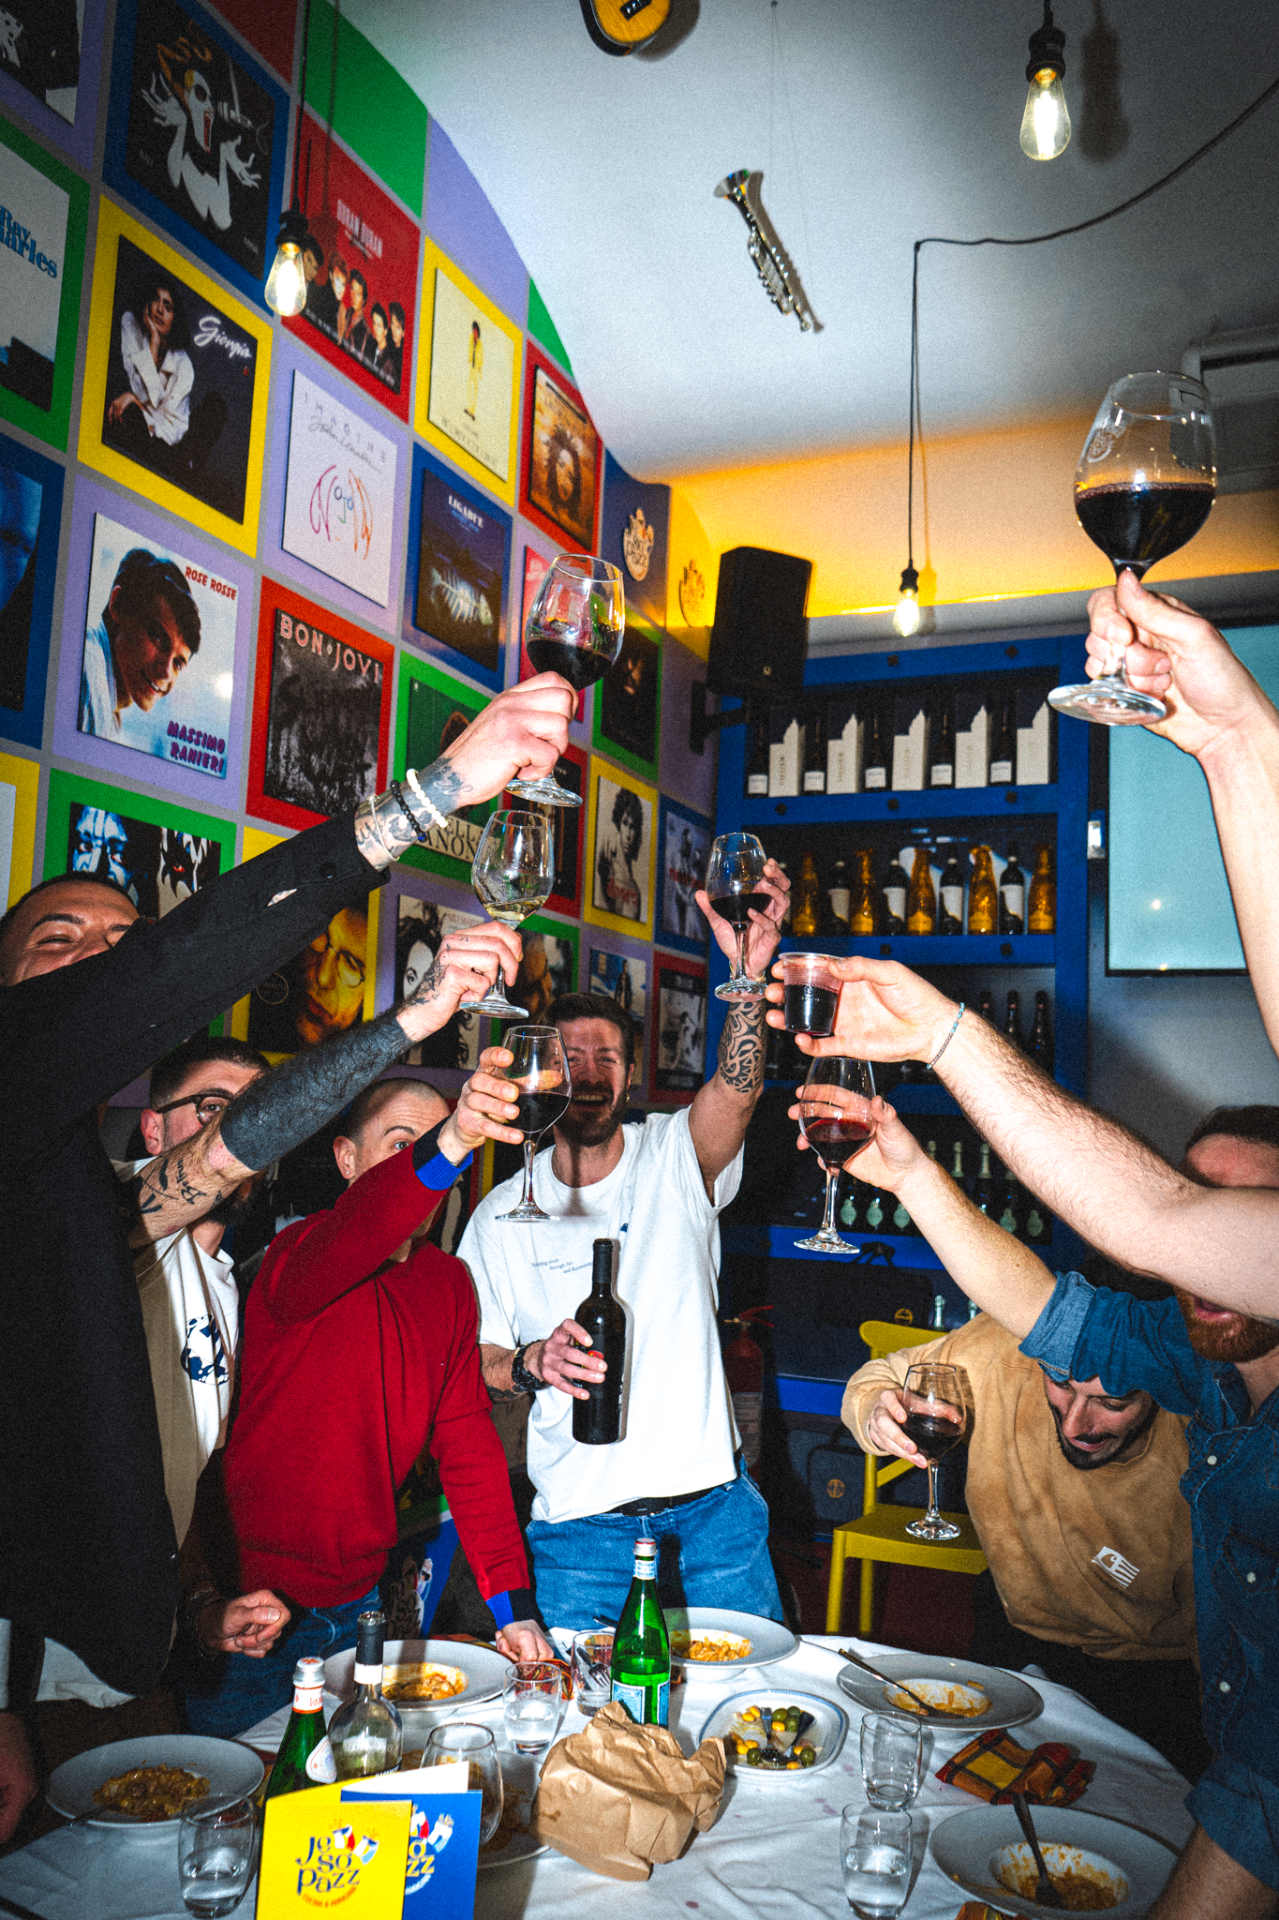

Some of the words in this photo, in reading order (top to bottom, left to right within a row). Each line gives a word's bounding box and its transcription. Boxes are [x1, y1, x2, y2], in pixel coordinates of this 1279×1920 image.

[0, 222, 57, 278] arles
[193, 315, 252, 359] Giorgia
[185, 566, 208, 587] ROSE
[210, 578, 237, 601] ROSSE
[280, 613, 323, 656] BON
[331, 643, 379, 684] JOVI
[167, 720, 225, 754] MASSIMO
[170, 741, 224, 773] RANIERI
[296, 1836, 331, 1866] Je
